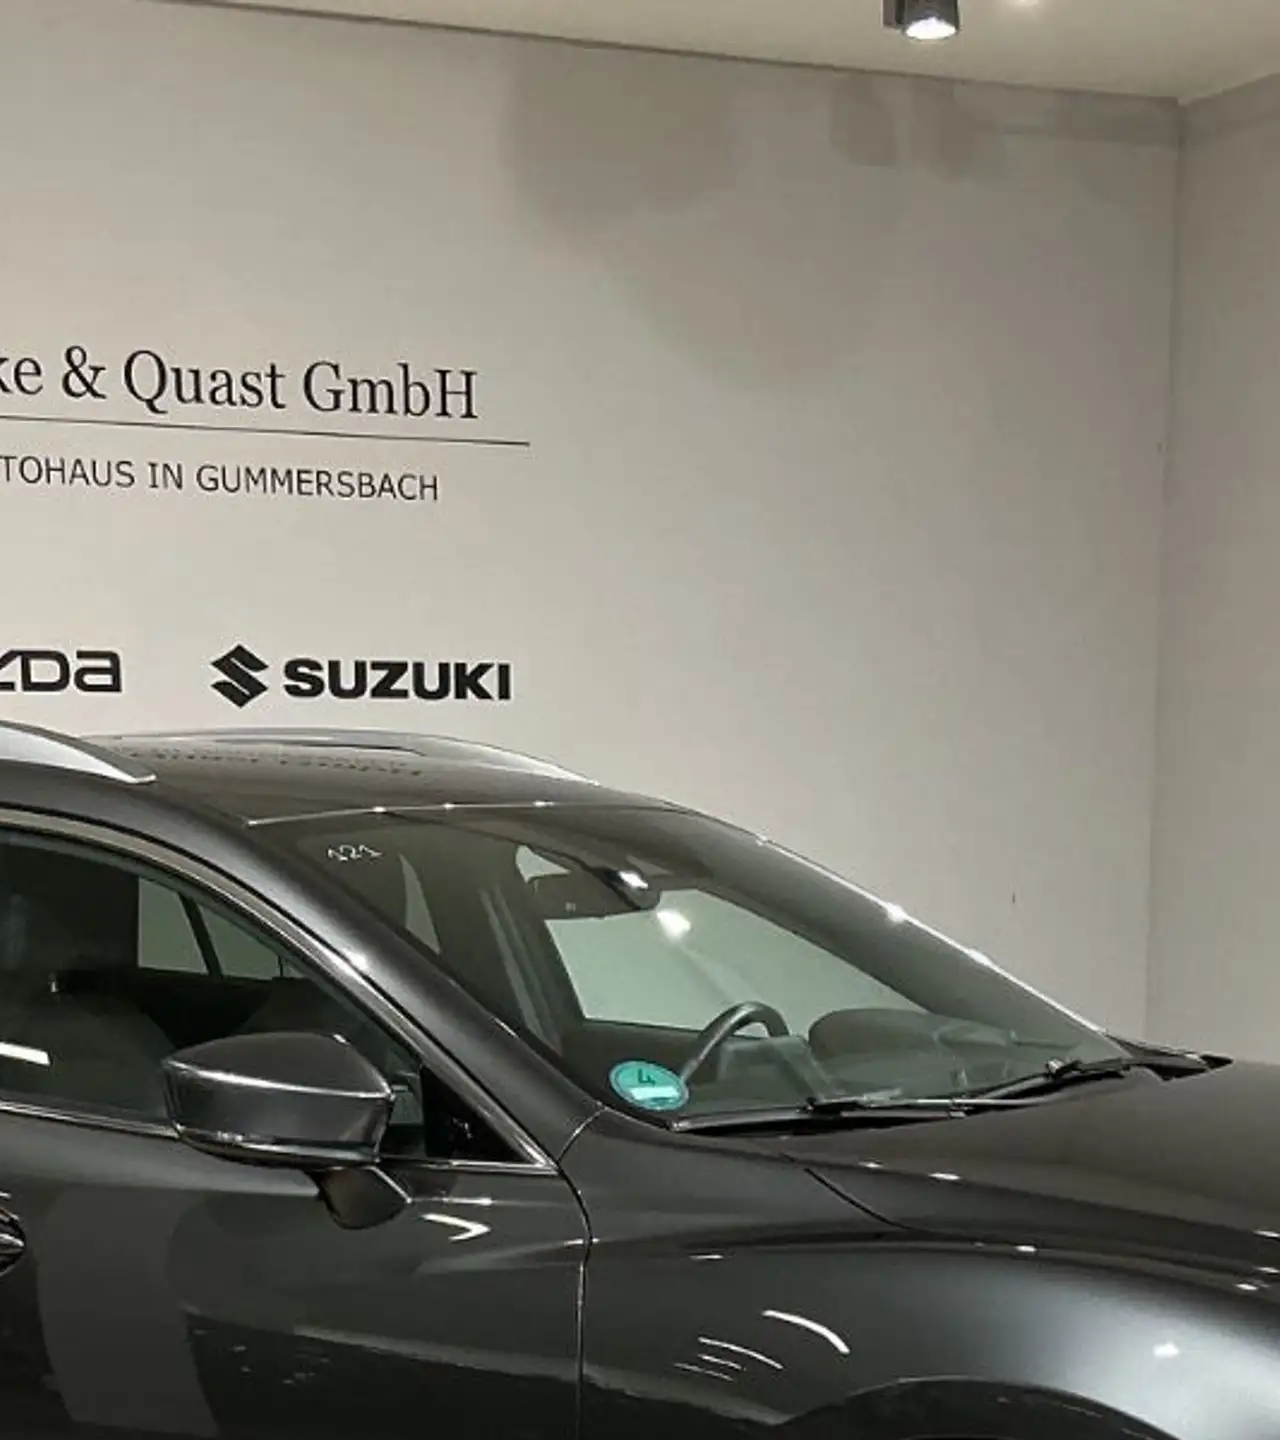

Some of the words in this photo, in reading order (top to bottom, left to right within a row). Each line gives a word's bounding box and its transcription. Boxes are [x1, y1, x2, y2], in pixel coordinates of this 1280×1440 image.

[61, 345, 108, 400] &
[123, 349, 287, 414] Quast
[303, 360, 479, 420] GmbH
[147, 461, 183, 491] IN
[195, 464, 438, 502] GUMMERSBACH
[283, 657, 512, 701] SUZUKI
